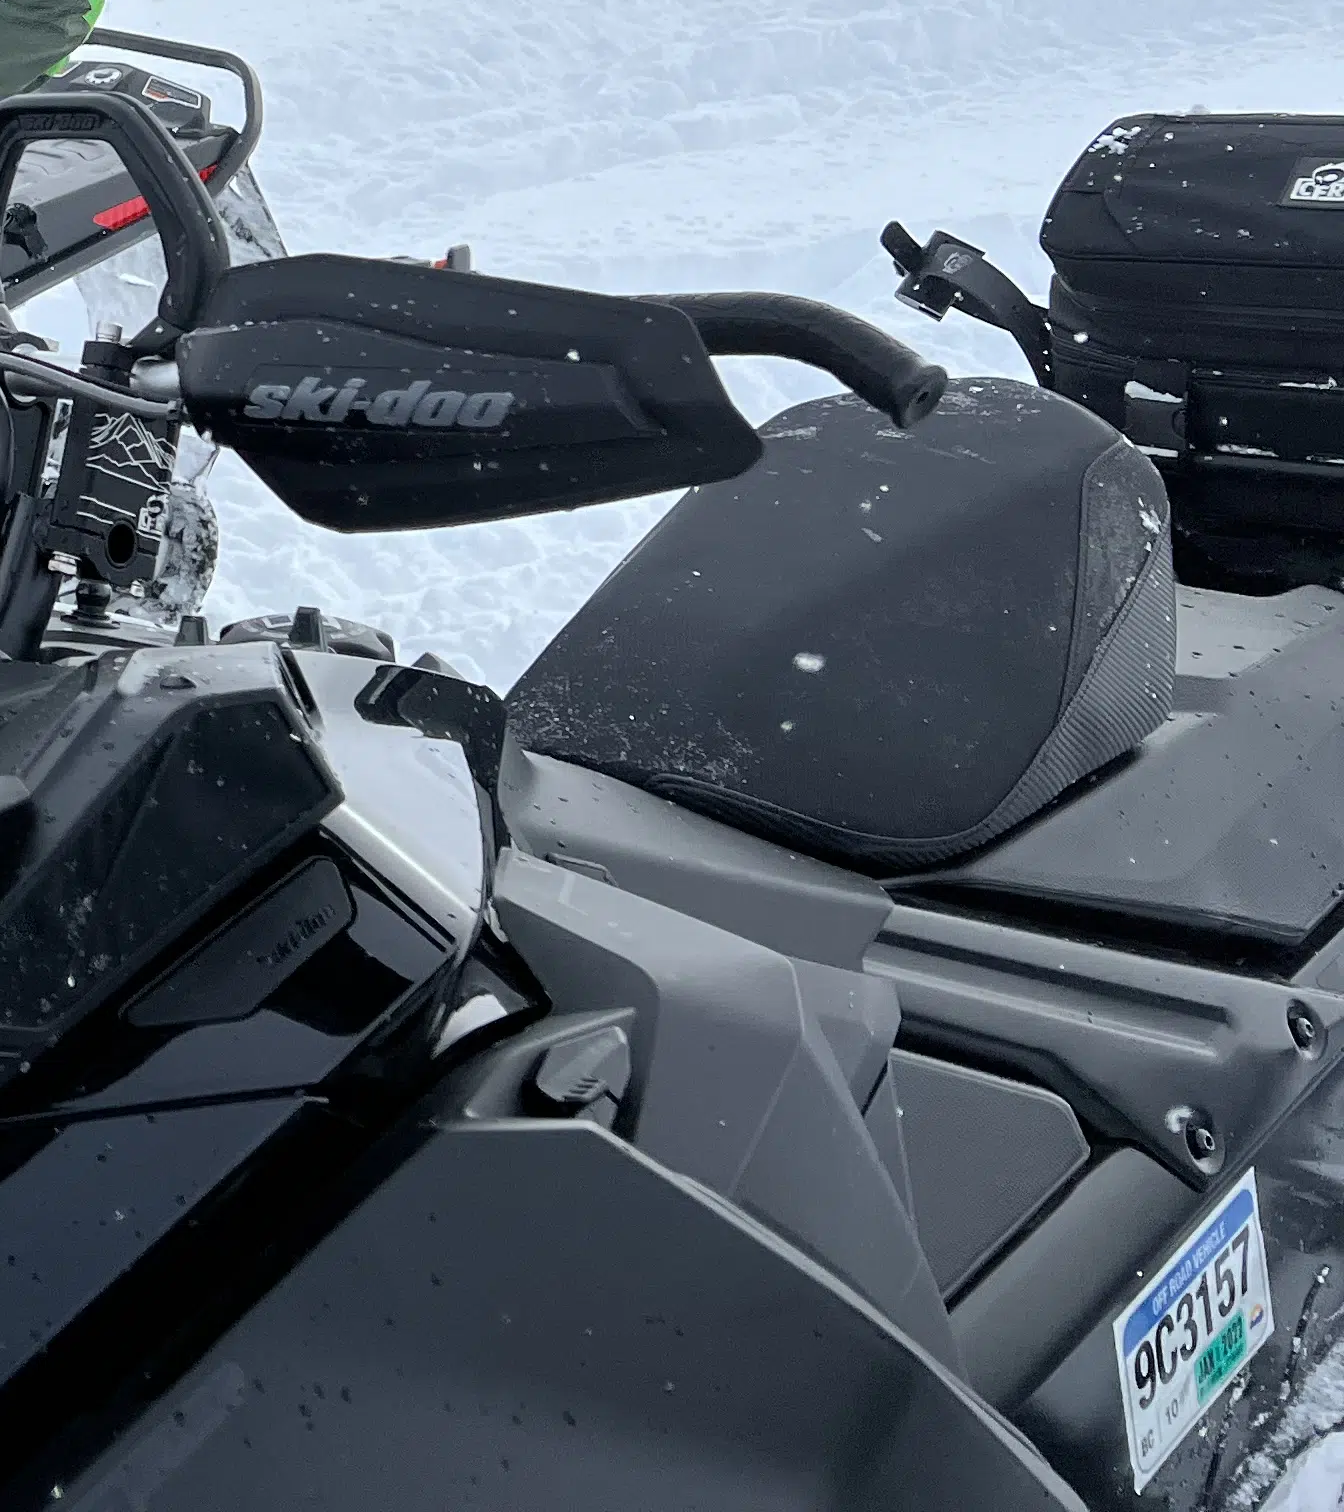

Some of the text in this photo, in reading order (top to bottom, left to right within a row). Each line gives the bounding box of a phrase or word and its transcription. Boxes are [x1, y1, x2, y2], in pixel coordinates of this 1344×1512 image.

[243, 376, 513, 428] ski-doo
[1152, 1220, 1227, 1316] OFF ROAD VEHICLE
[1134, 1224, 1249, 1410] 9C3157
